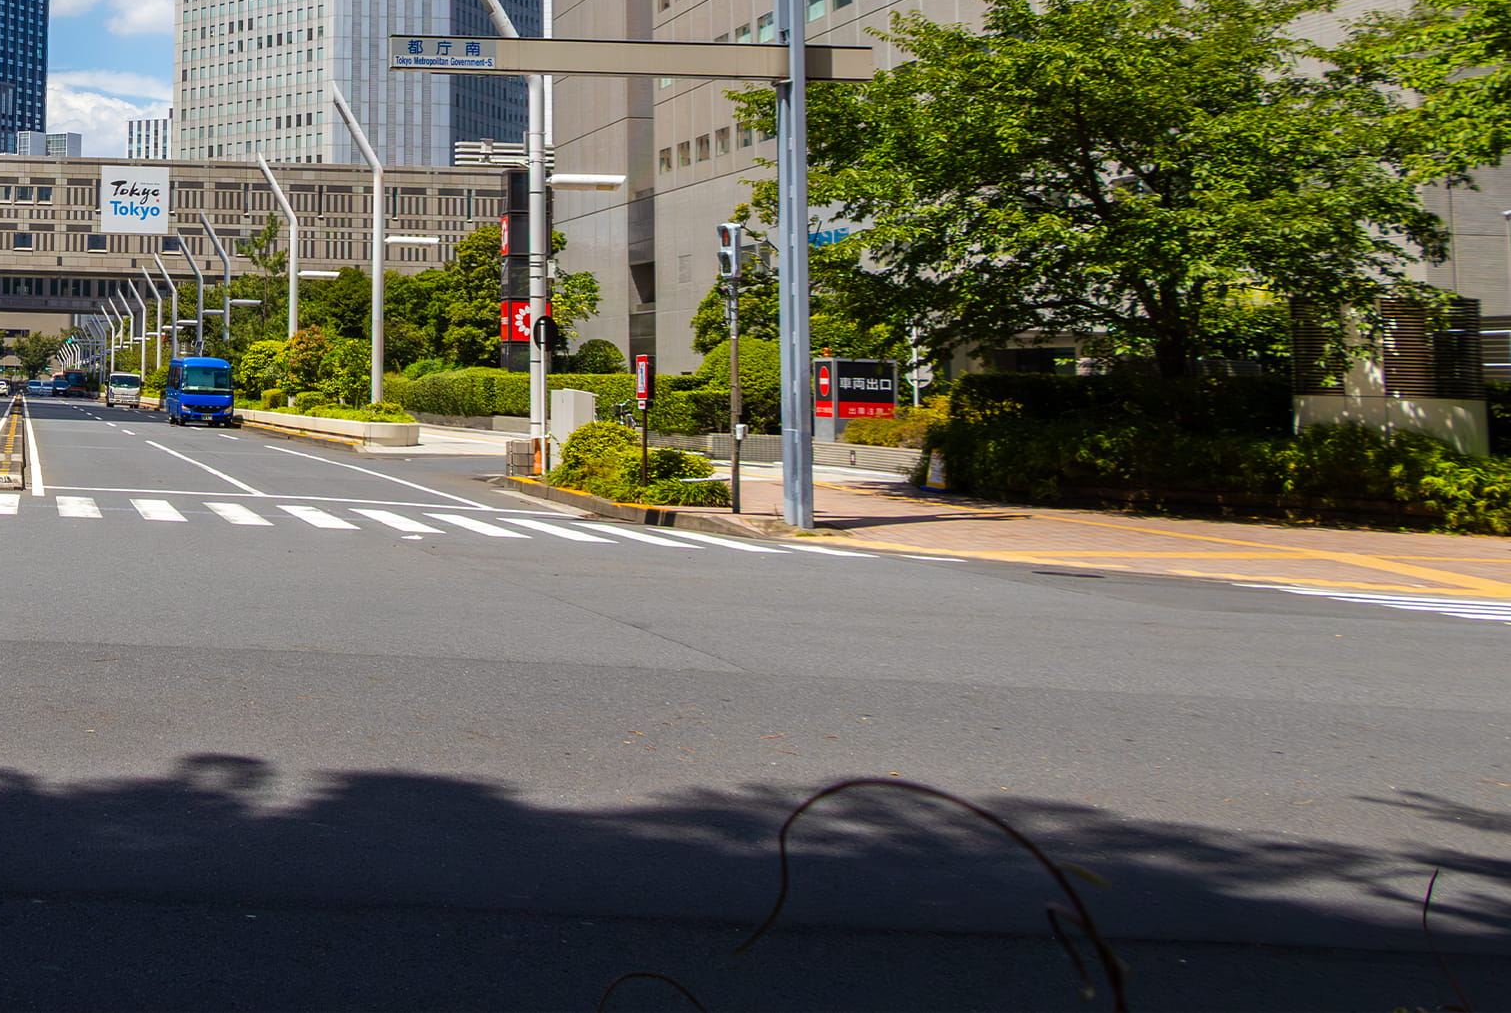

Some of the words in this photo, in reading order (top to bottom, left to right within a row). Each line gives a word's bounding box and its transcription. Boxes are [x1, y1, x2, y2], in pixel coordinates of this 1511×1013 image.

[408, 40, 481, 56] 都庁南
[395, 56, 412, 66] Tokyo
[414, 57, 449, 67] Metropolitan
[110, 180, 160, 205] Tokyo
[109, 200, 160, 220] Tokyo
[839, 377, 892, 391] 車両出口
